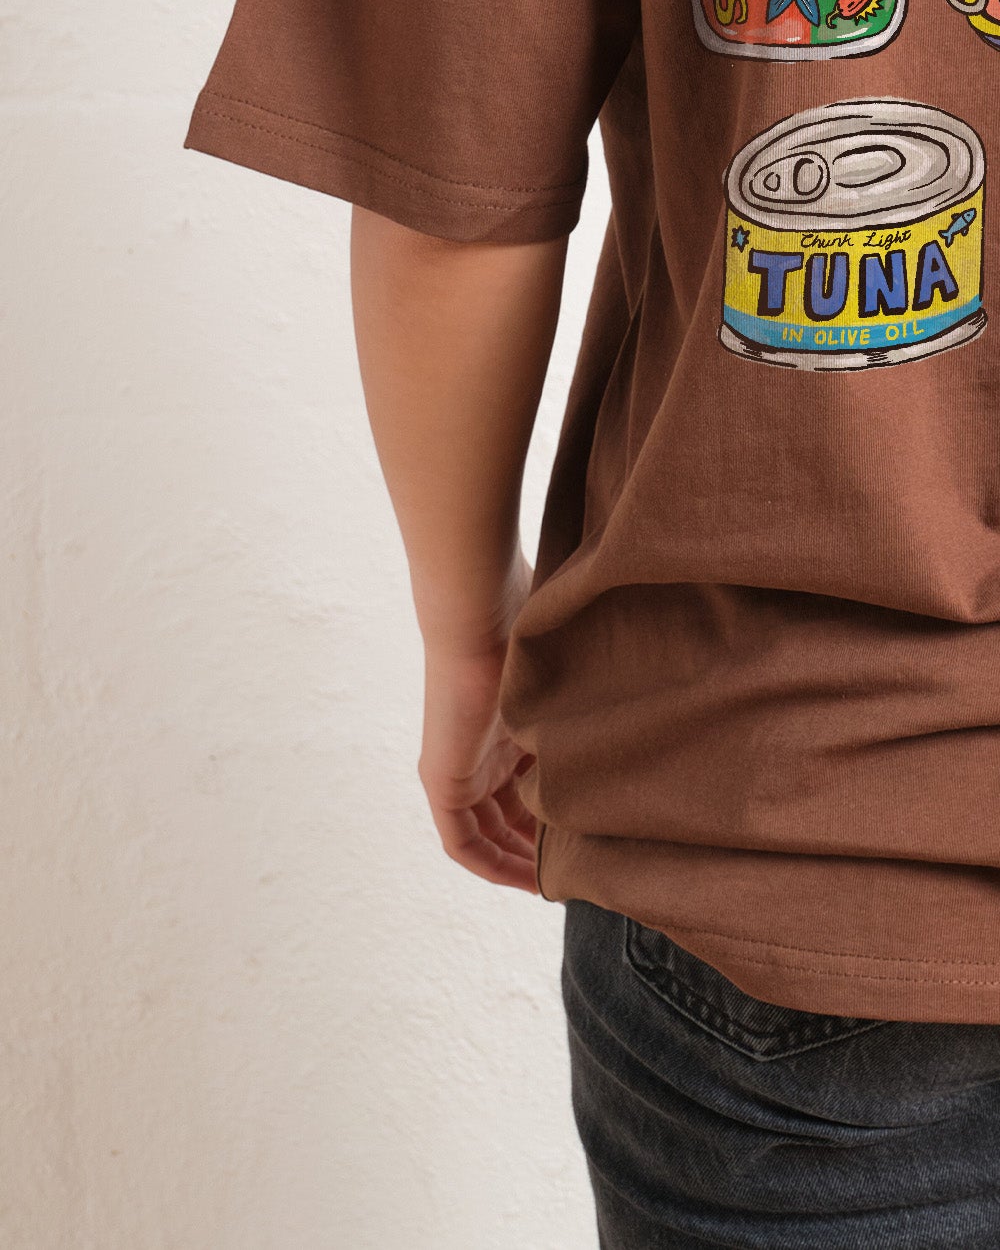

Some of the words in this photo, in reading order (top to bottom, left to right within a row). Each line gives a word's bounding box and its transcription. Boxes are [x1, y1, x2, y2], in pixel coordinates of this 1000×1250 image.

[800, 232, 854, 249] Chunk
[863, 230, 912, 250] Light
[747, 240, 959, 322] TUNA
[782, 327, 804, 342] IN
[814, 328, 870, 346] OLIVE
[885, 321, 924, 341] OIL
